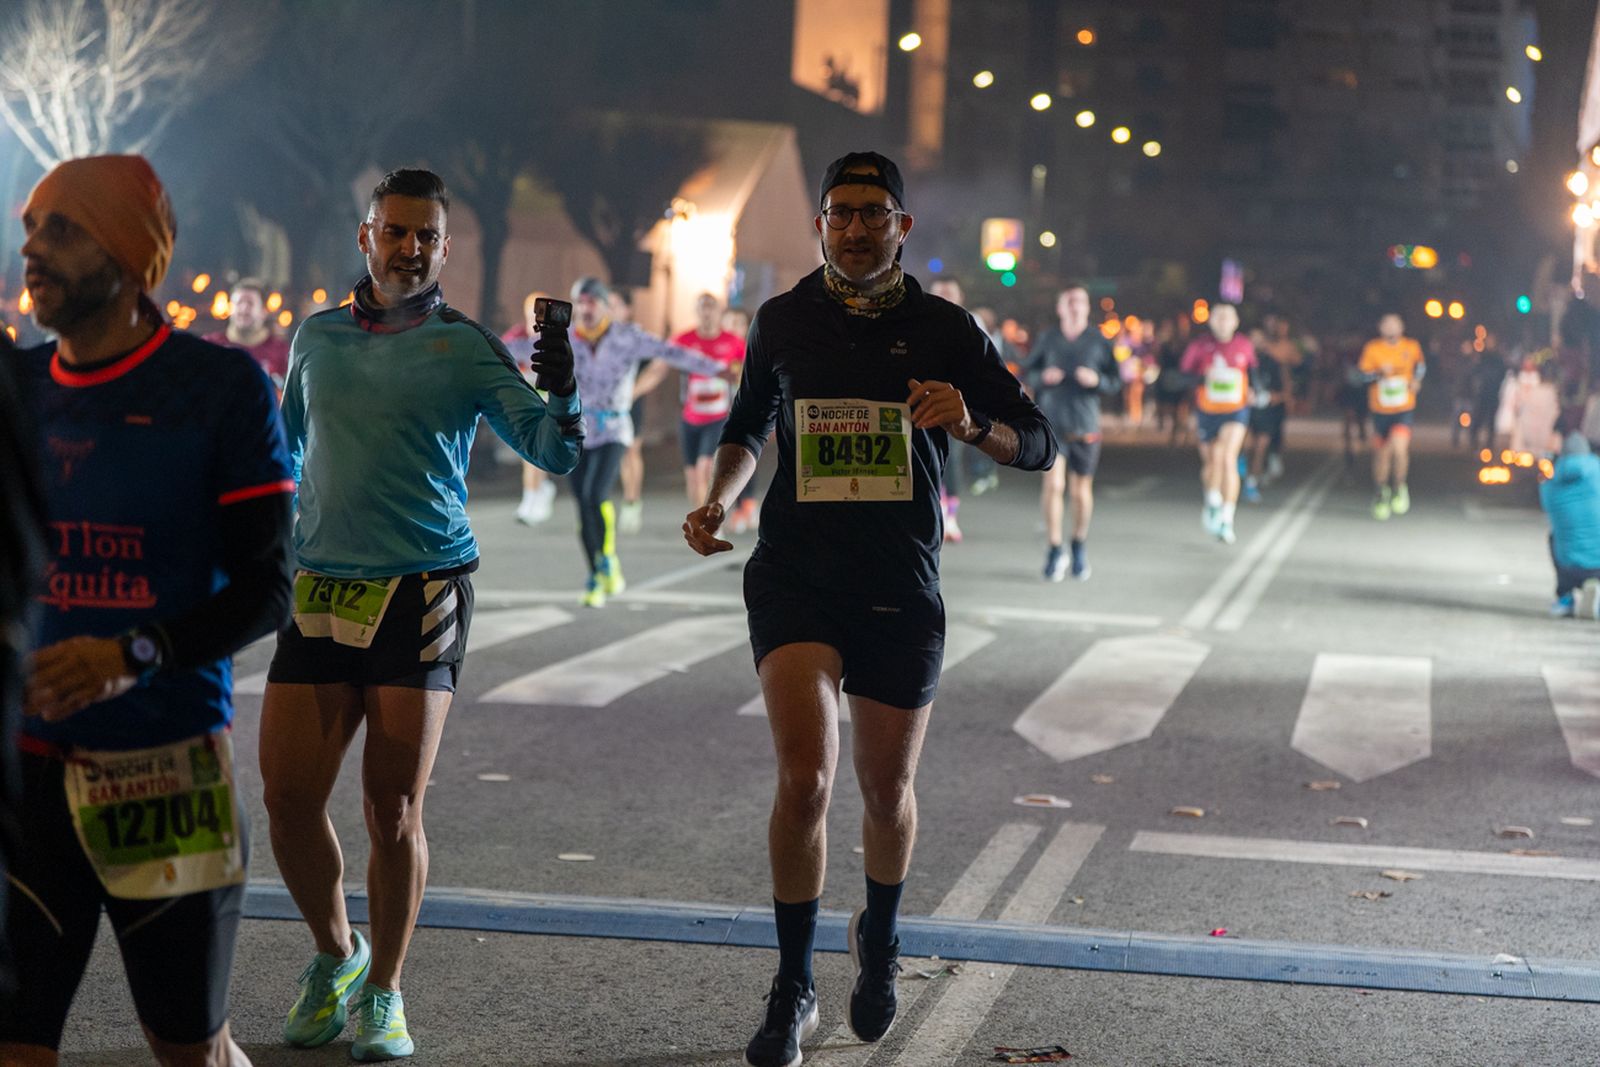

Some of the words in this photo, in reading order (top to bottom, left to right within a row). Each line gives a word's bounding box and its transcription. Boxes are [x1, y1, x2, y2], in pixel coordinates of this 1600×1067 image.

[821, 410, 855, 419] NOCHE
[857, 409, 869, 419] DE
[808, 422, 831, 433] SAN
[832, 419, 870, 433] ANTÓN
[818, 434, 891, 466] 8492
[97, 790, 220, 848] 12704
